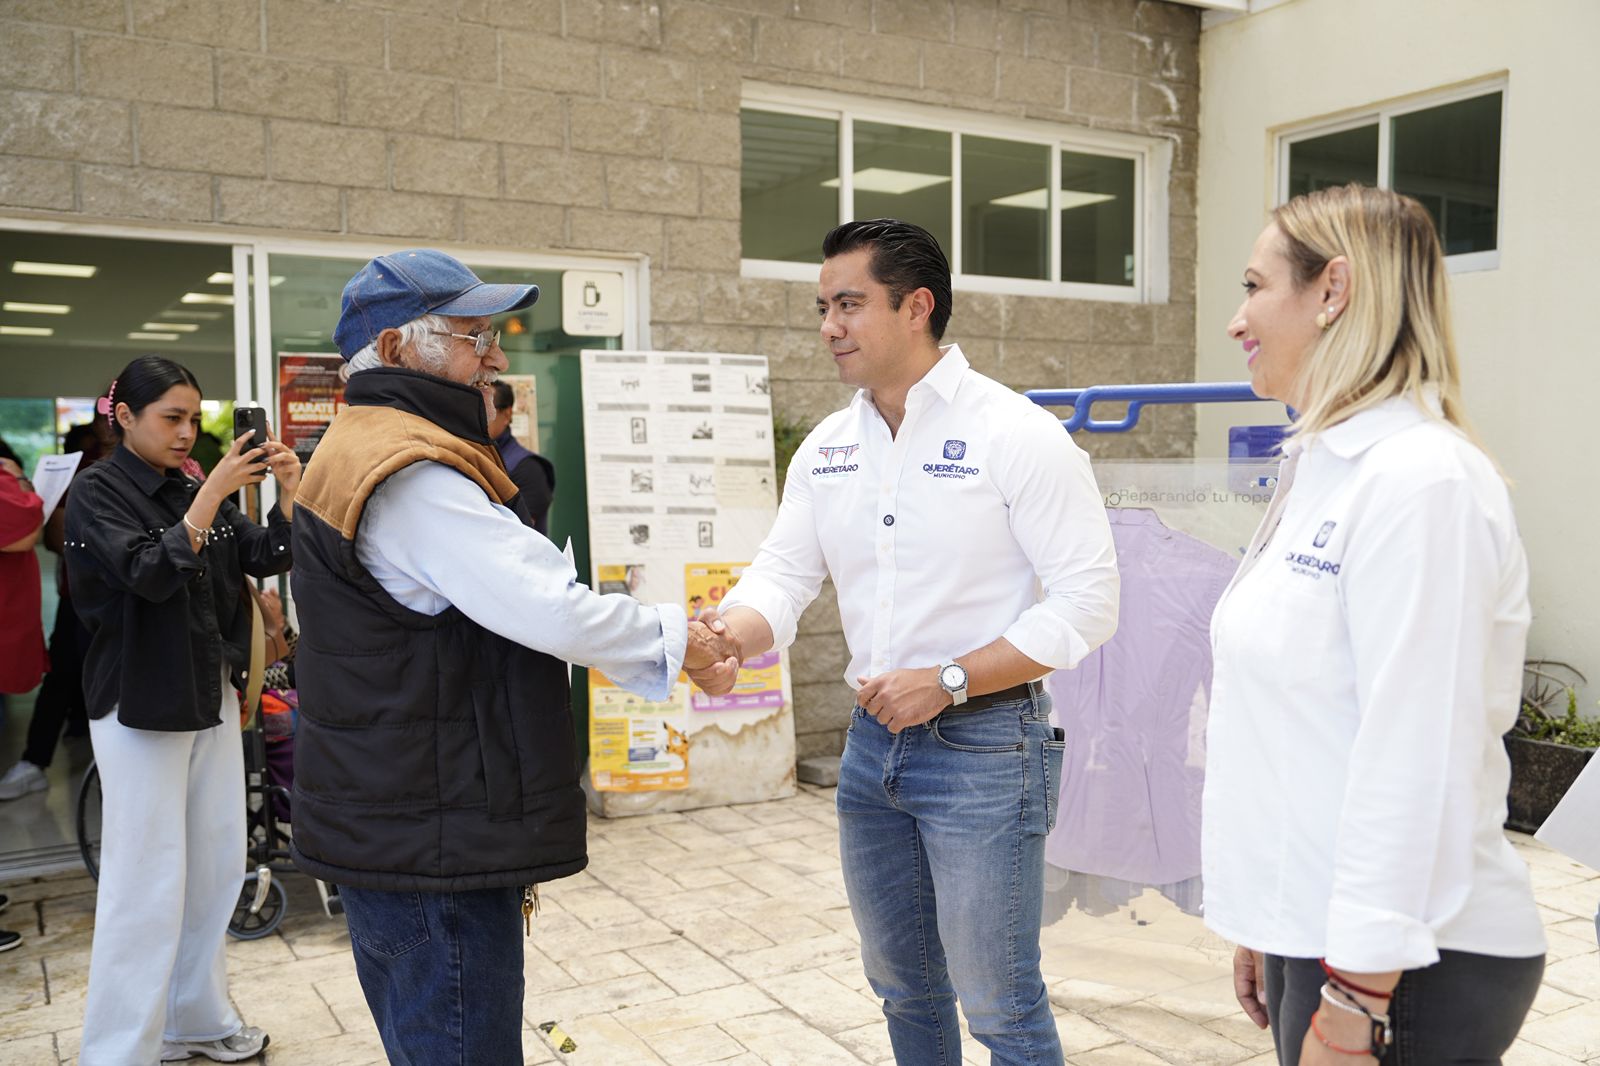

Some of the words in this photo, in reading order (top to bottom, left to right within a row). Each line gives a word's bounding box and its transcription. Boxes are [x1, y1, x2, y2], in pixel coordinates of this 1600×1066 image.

[288, 402, 335, 414] KARATE
[1120, 489, 1206, 503] Reparando
[1213, 492, 1228, 503] tu
[1234, 493, 1273, 505] ropa
